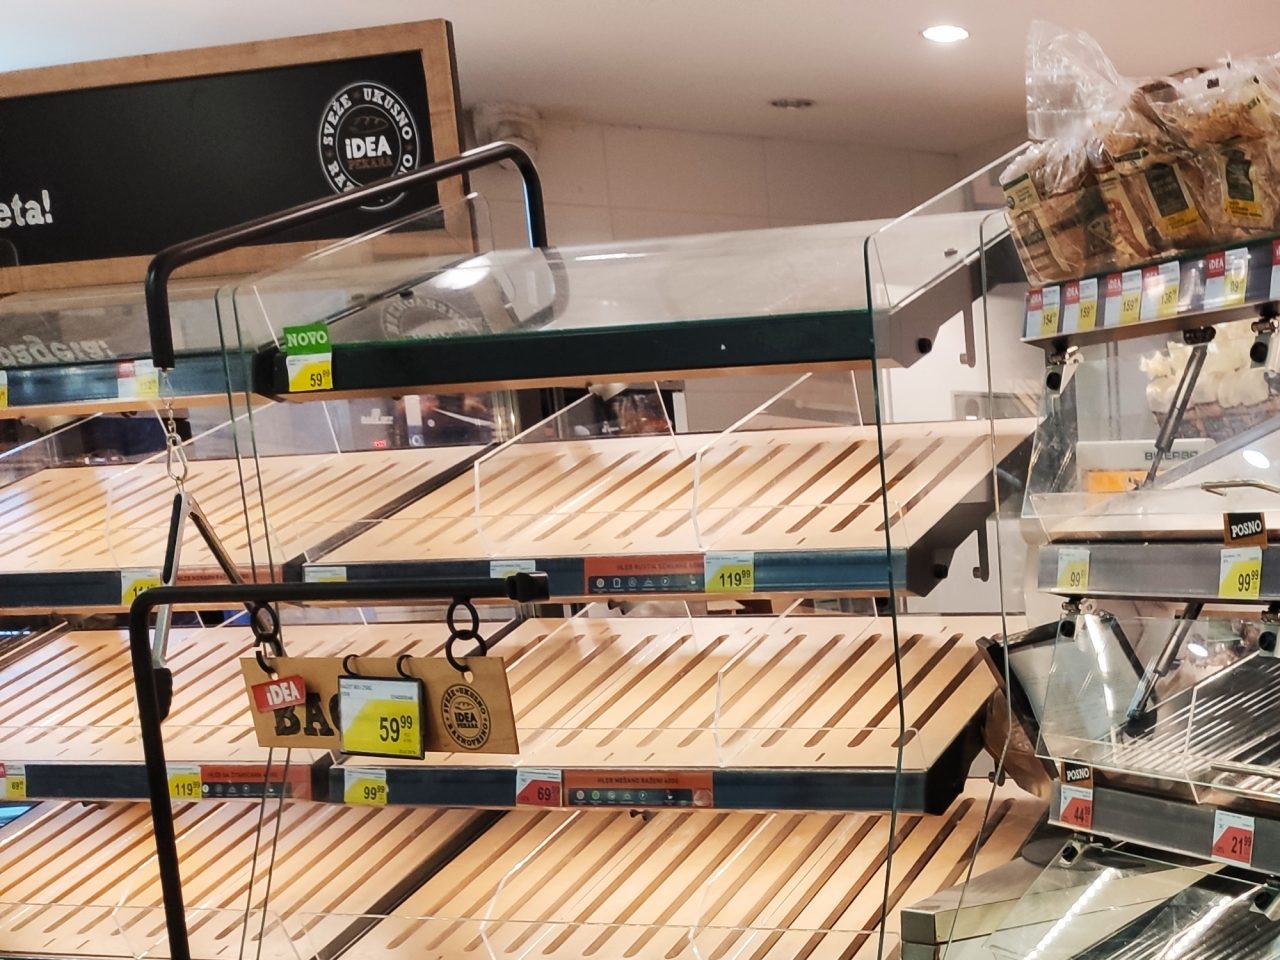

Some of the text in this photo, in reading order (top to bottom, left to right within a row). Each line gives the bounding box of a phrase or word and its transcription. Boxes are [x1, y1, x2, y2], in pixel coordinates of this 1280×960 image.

[286, 330, 328, 348] NOVO
[1230, 519, 1262, 538] POSNO
[1066, 767, 1090, 782] POSNO
